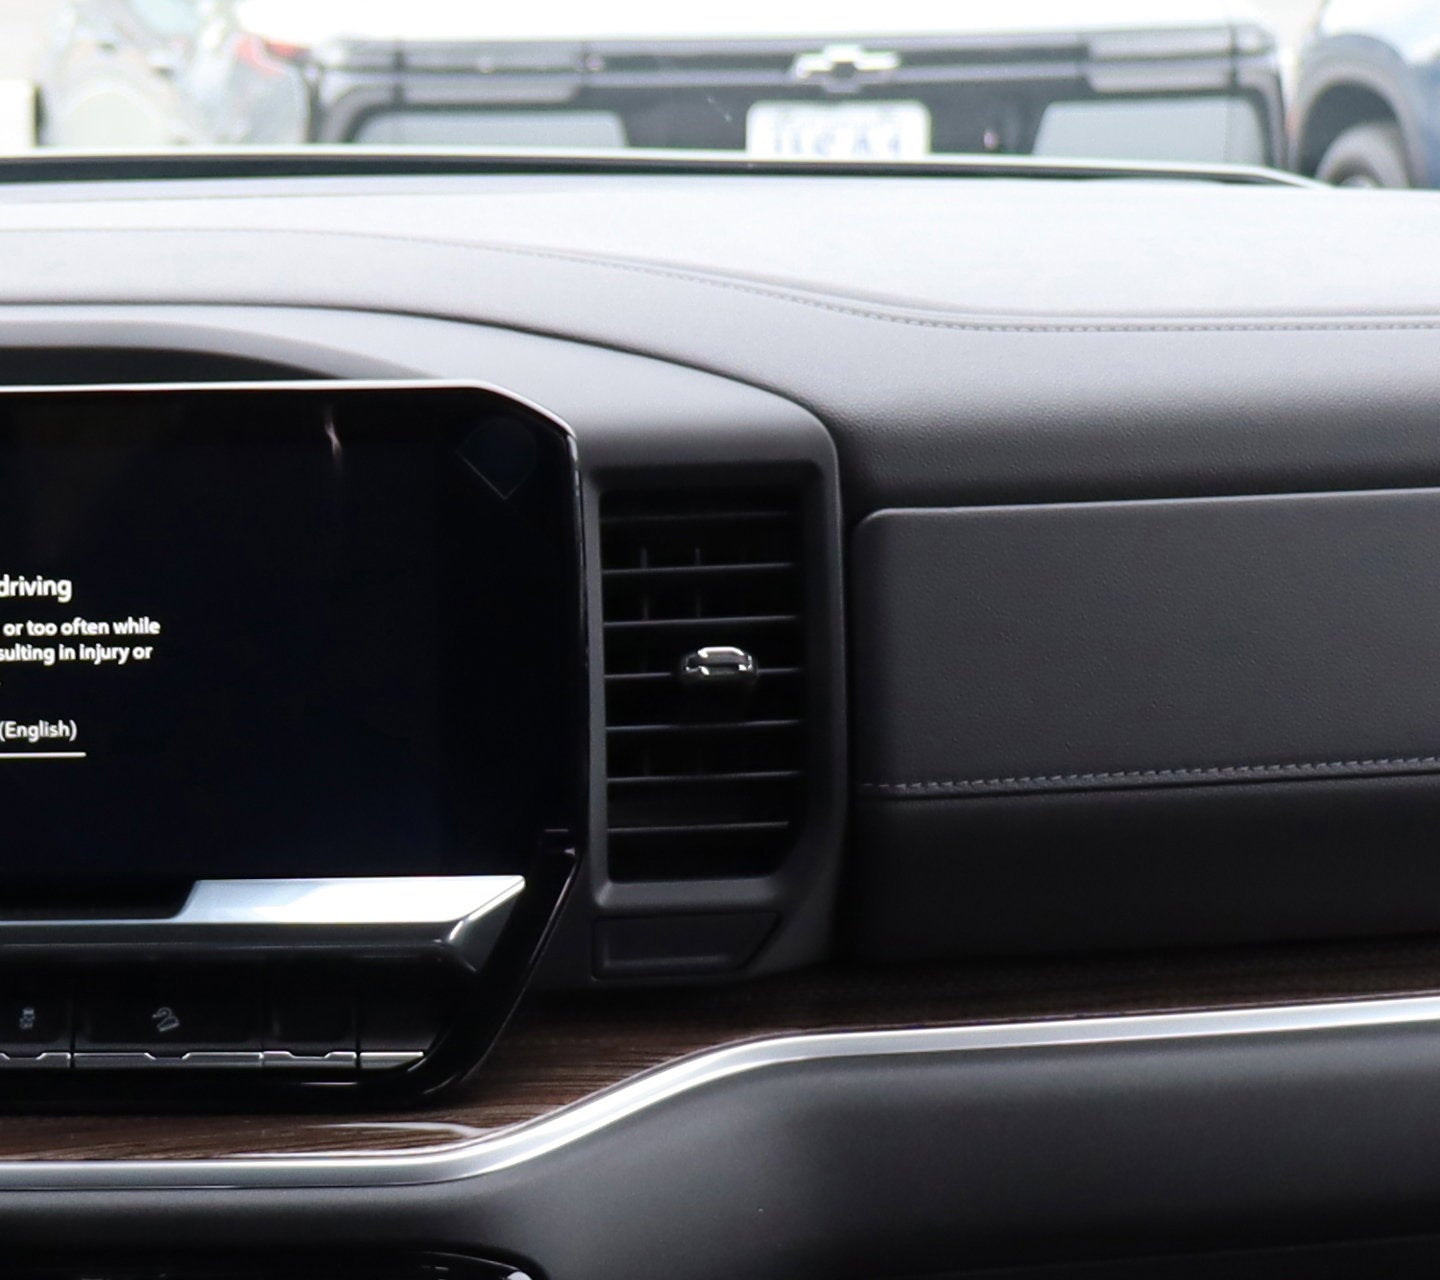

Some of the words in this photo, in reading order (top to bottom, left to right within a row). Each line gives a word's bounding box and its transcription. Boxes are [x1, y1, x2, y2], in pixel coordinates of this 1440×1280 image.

[2, 623, 23, 636] or
[26, 620, 57, 636] too
[60, 617, 109, 635] often
[112, 616, 160, 634] while
[58, 643, 75, 660] in
[78, 643, 129, 664] injury
[132, 646, 152, 659] or
